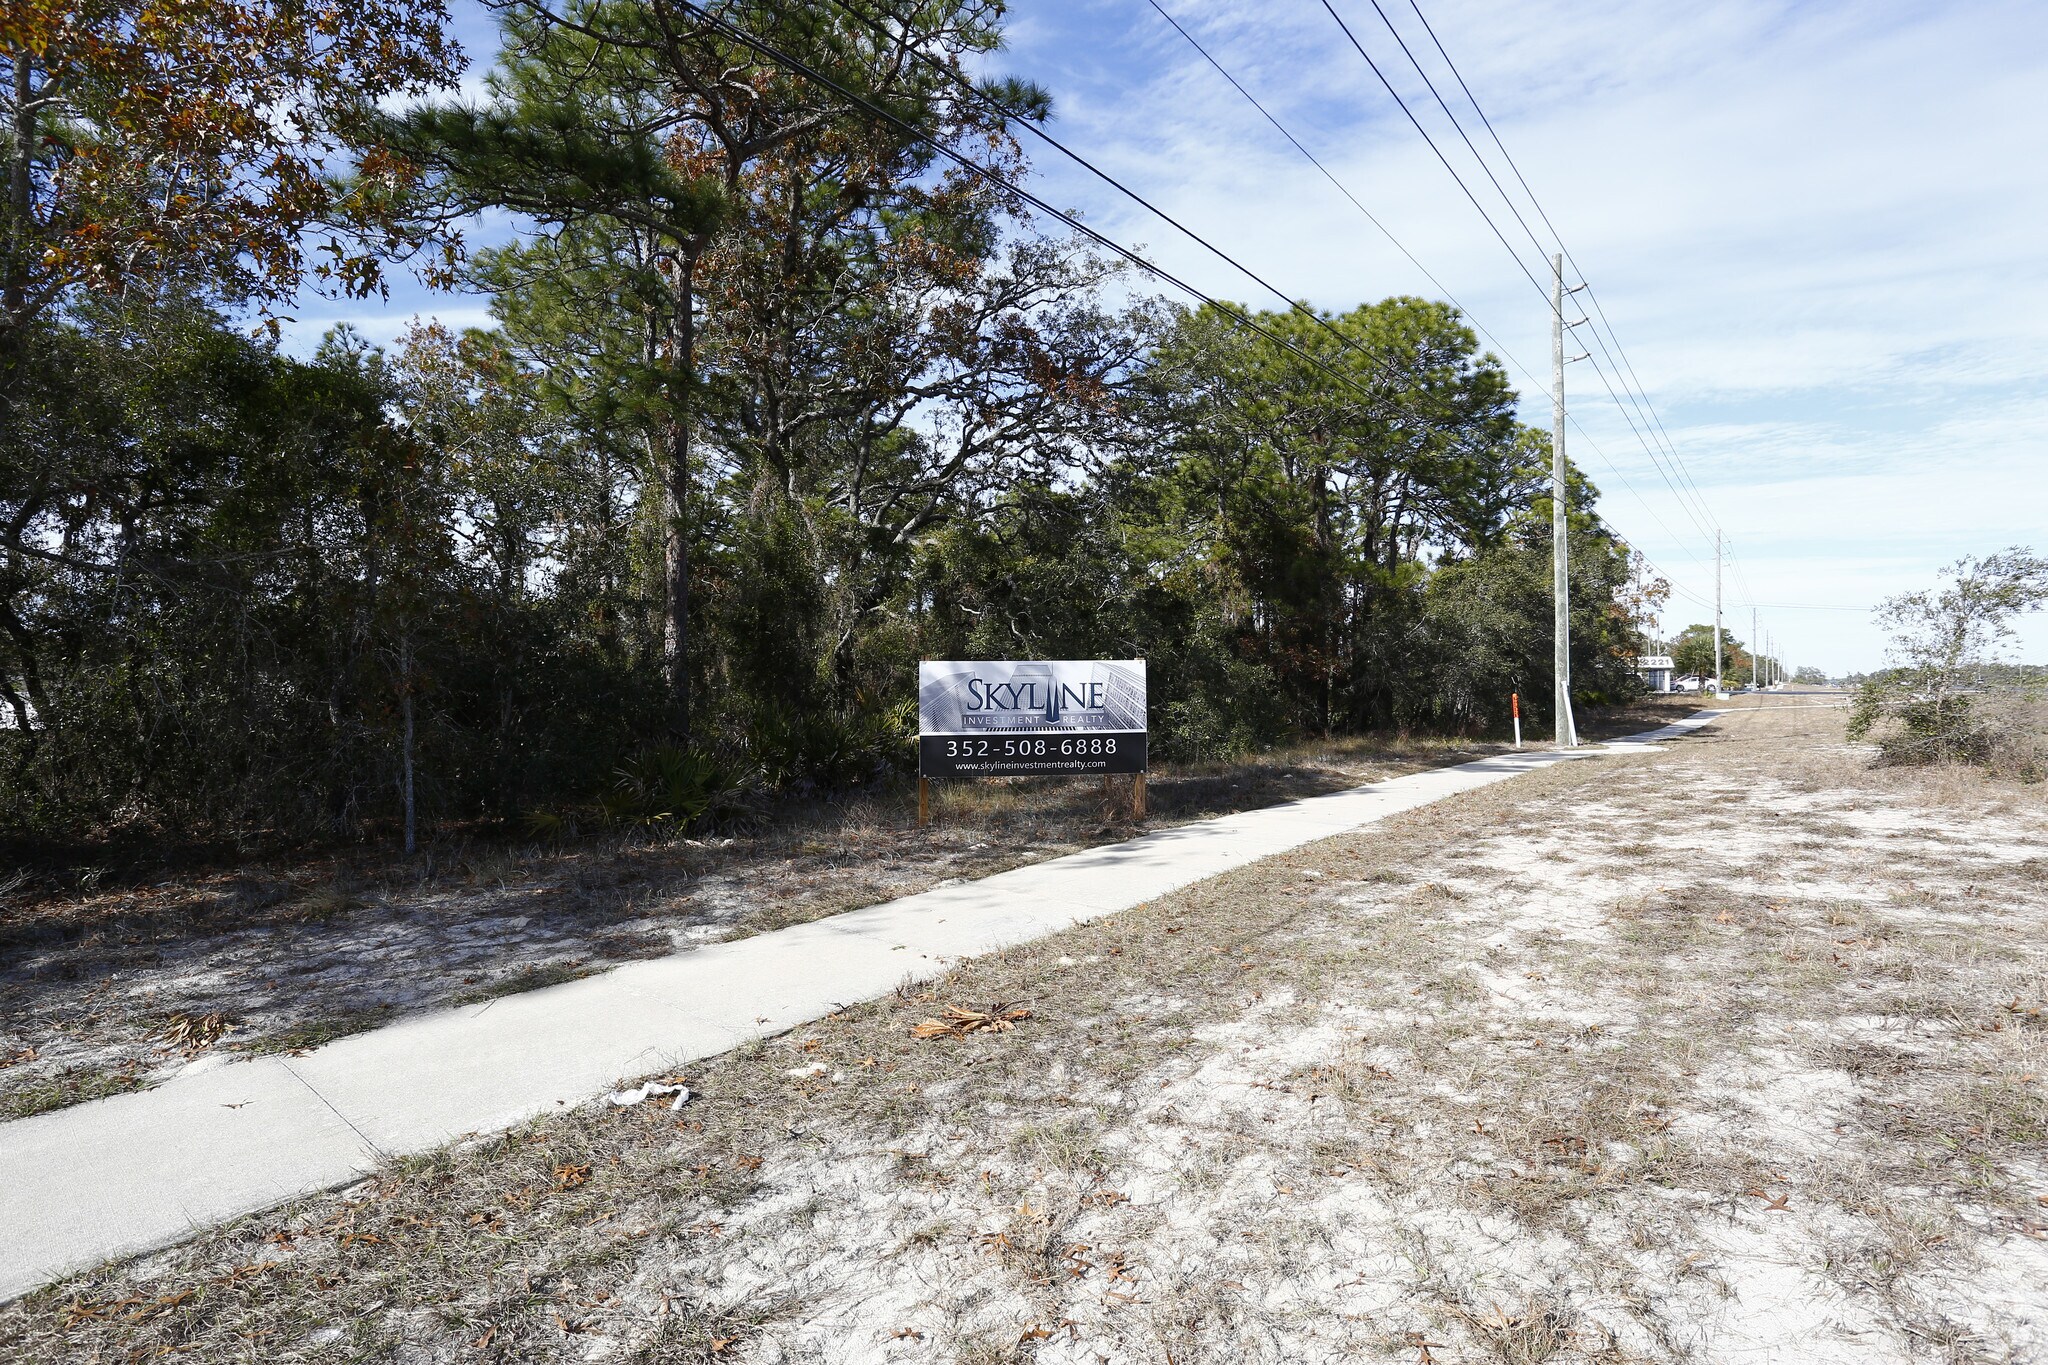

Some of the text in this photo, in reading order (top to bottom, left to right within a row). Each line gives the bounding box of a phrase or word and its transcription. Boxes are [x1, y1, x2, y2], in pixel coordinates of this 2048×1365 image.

[967, 678, 1105, 721] SKYLINE
[963, 715, 1105, 725] INVESTMENT REALTY
[946, 738, 1117, 757] 352-508-6888
[955, 760, 1106, 771] www.skylineinvestmentrealty.com
